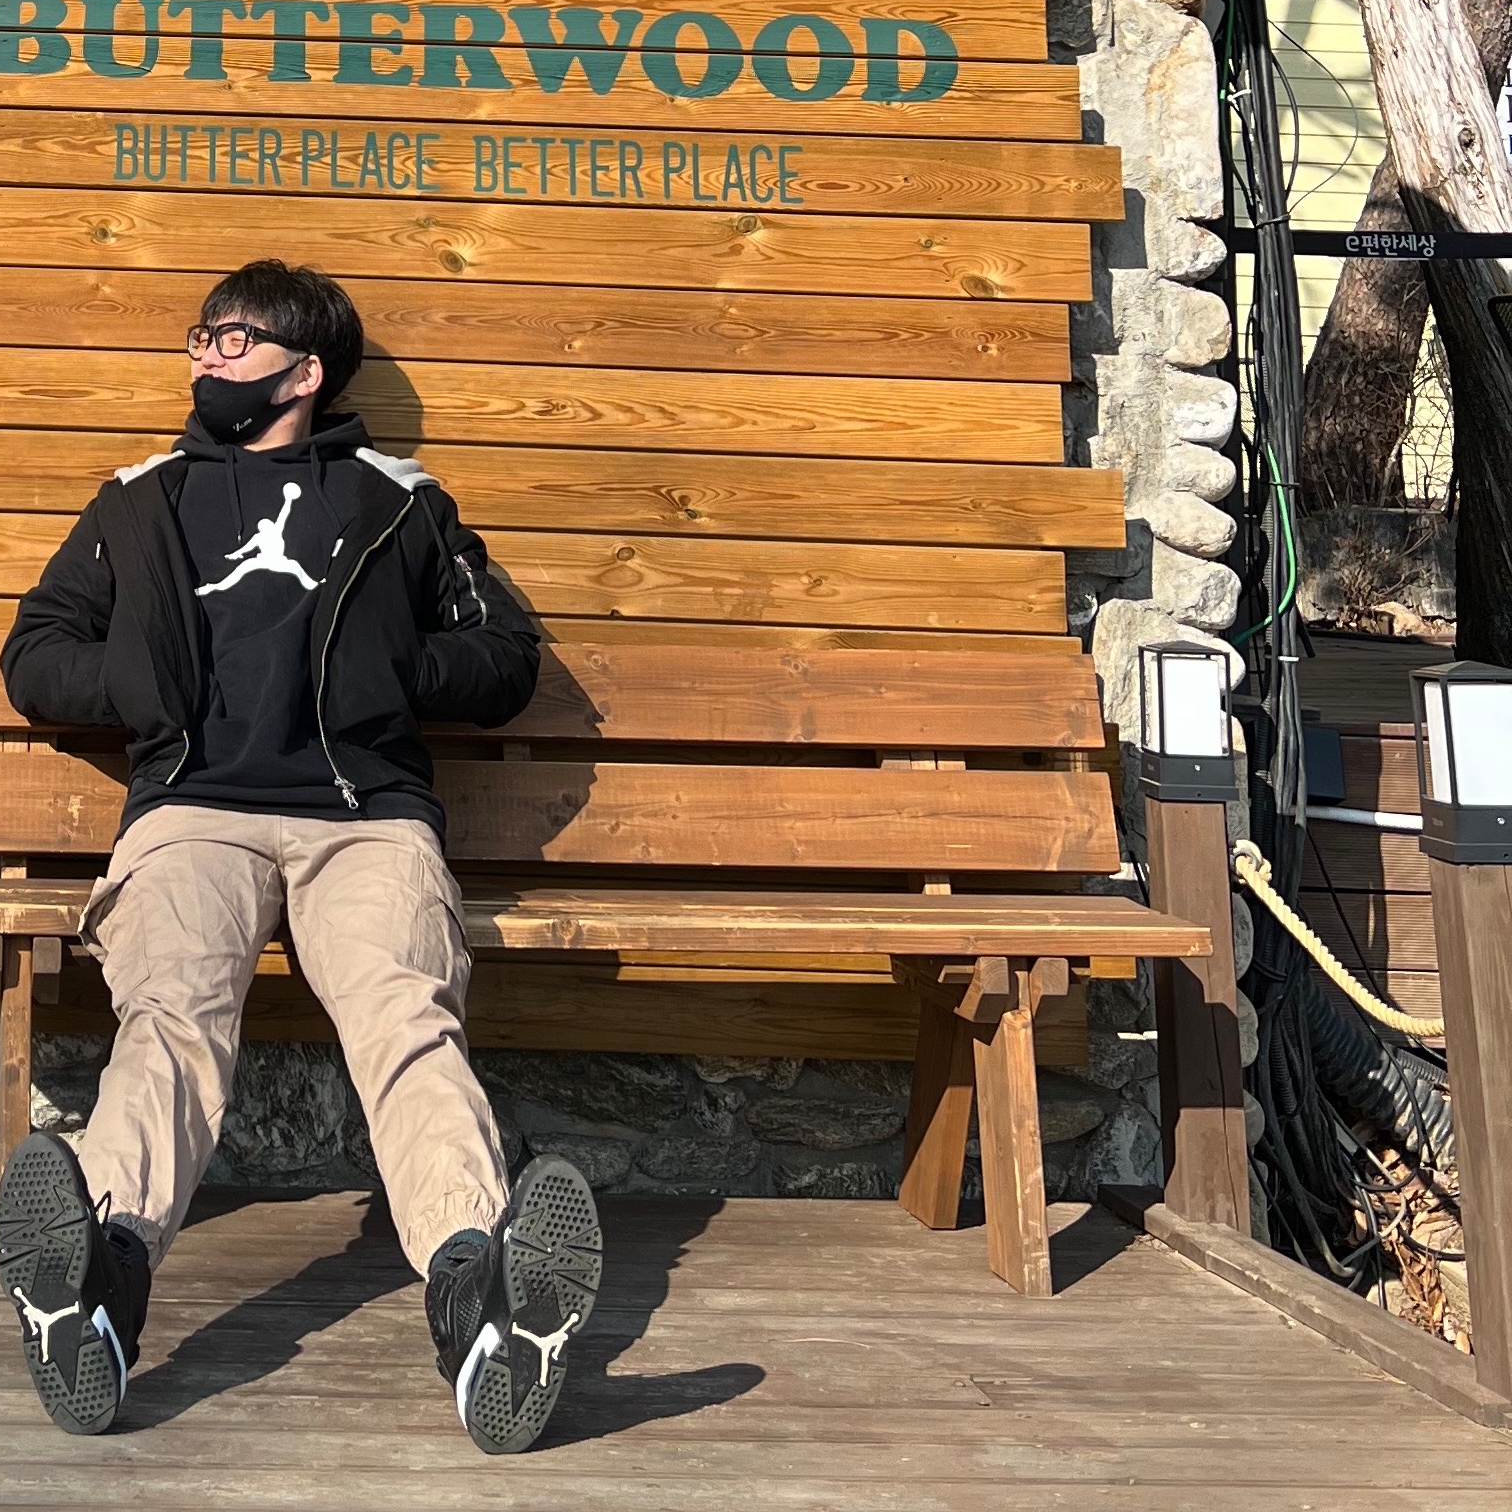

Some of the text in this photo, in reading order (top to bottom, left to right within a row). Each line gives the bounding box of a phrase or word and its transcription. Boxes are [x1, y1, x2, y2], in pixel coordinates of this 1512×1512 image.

[113, 122, 806, 204] BUTTER PLACE BETTER PLACE
[1345, 233, 1437, 257] e편한세상
